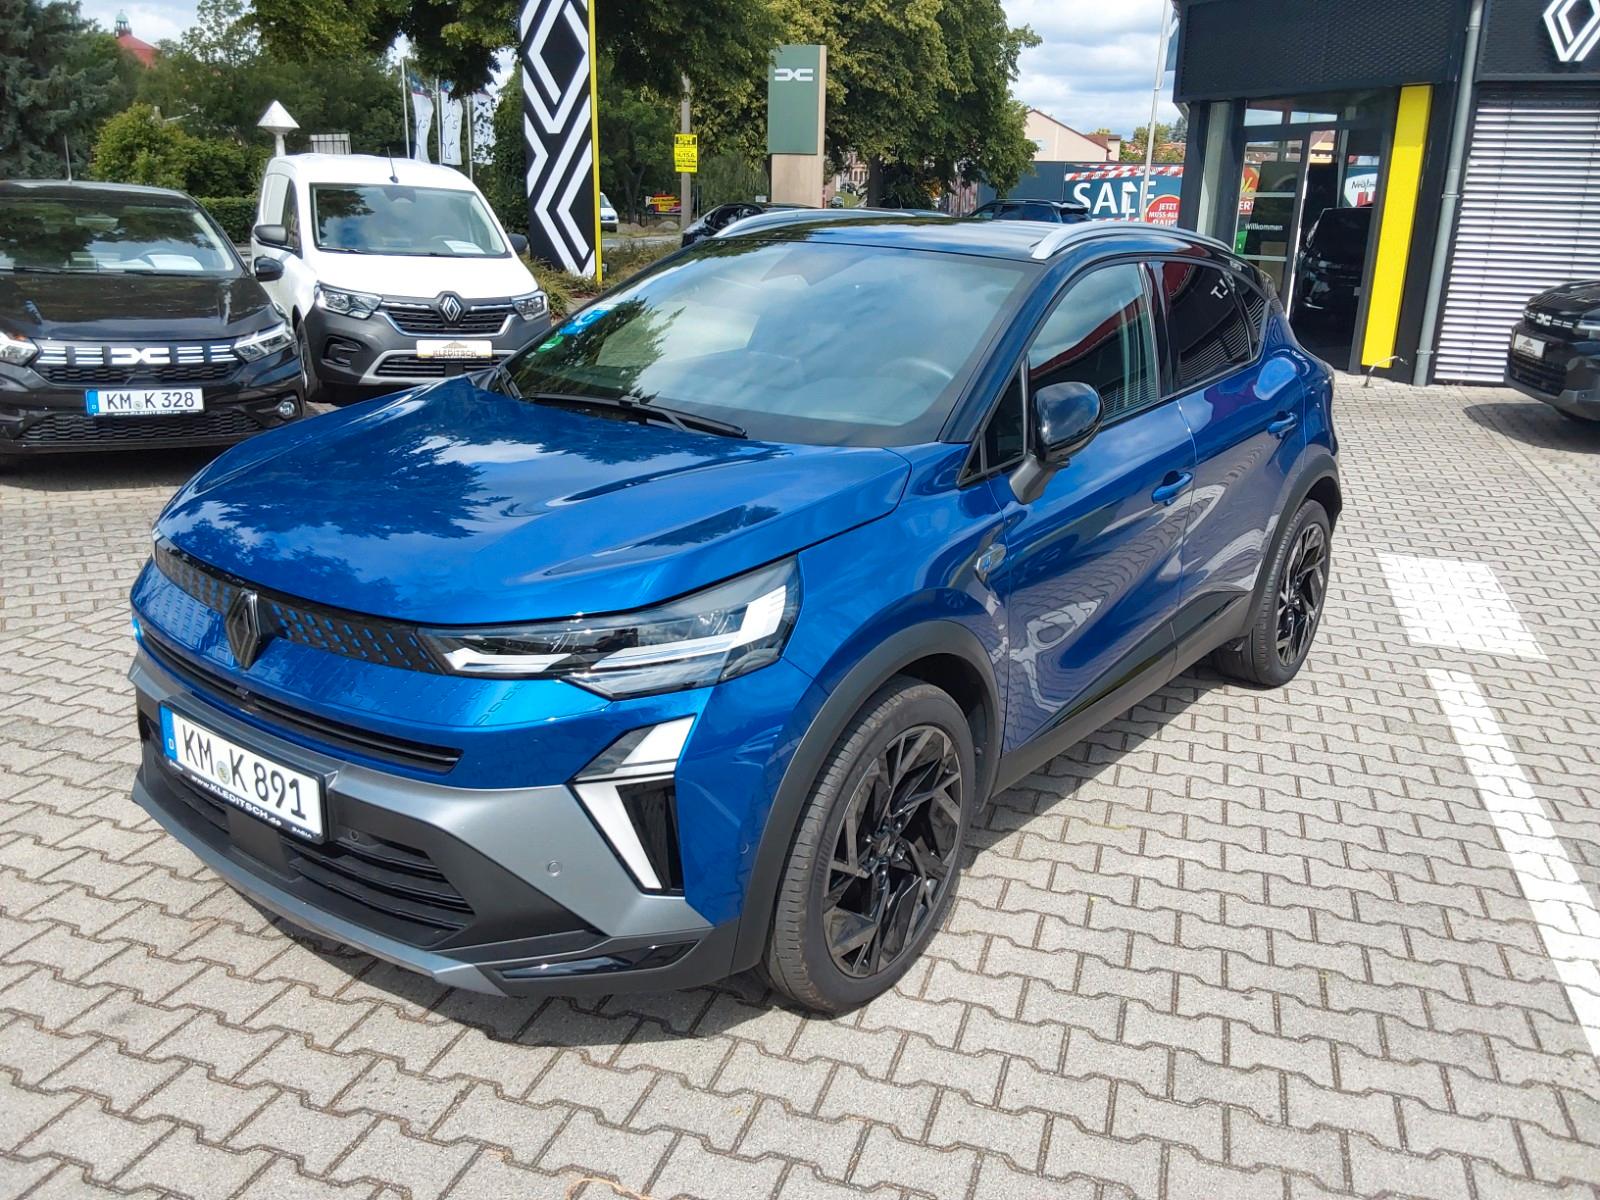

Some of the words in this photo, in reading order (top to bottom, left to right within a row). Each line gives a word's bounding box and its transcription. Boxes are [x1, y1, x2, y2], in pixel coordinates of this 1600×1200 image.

[1073, 181, 1156, 214] SALE
[1245, 223, 1283, 231] Willkommen
[106, 393, 131, 410] KM
[144, 393, 156, 408] K
[161, 391, 194, 408] 328
[183, 724, 214, 776] KM
[229, 749, 248, 793] K
[253, 761, 307, 820] 891
